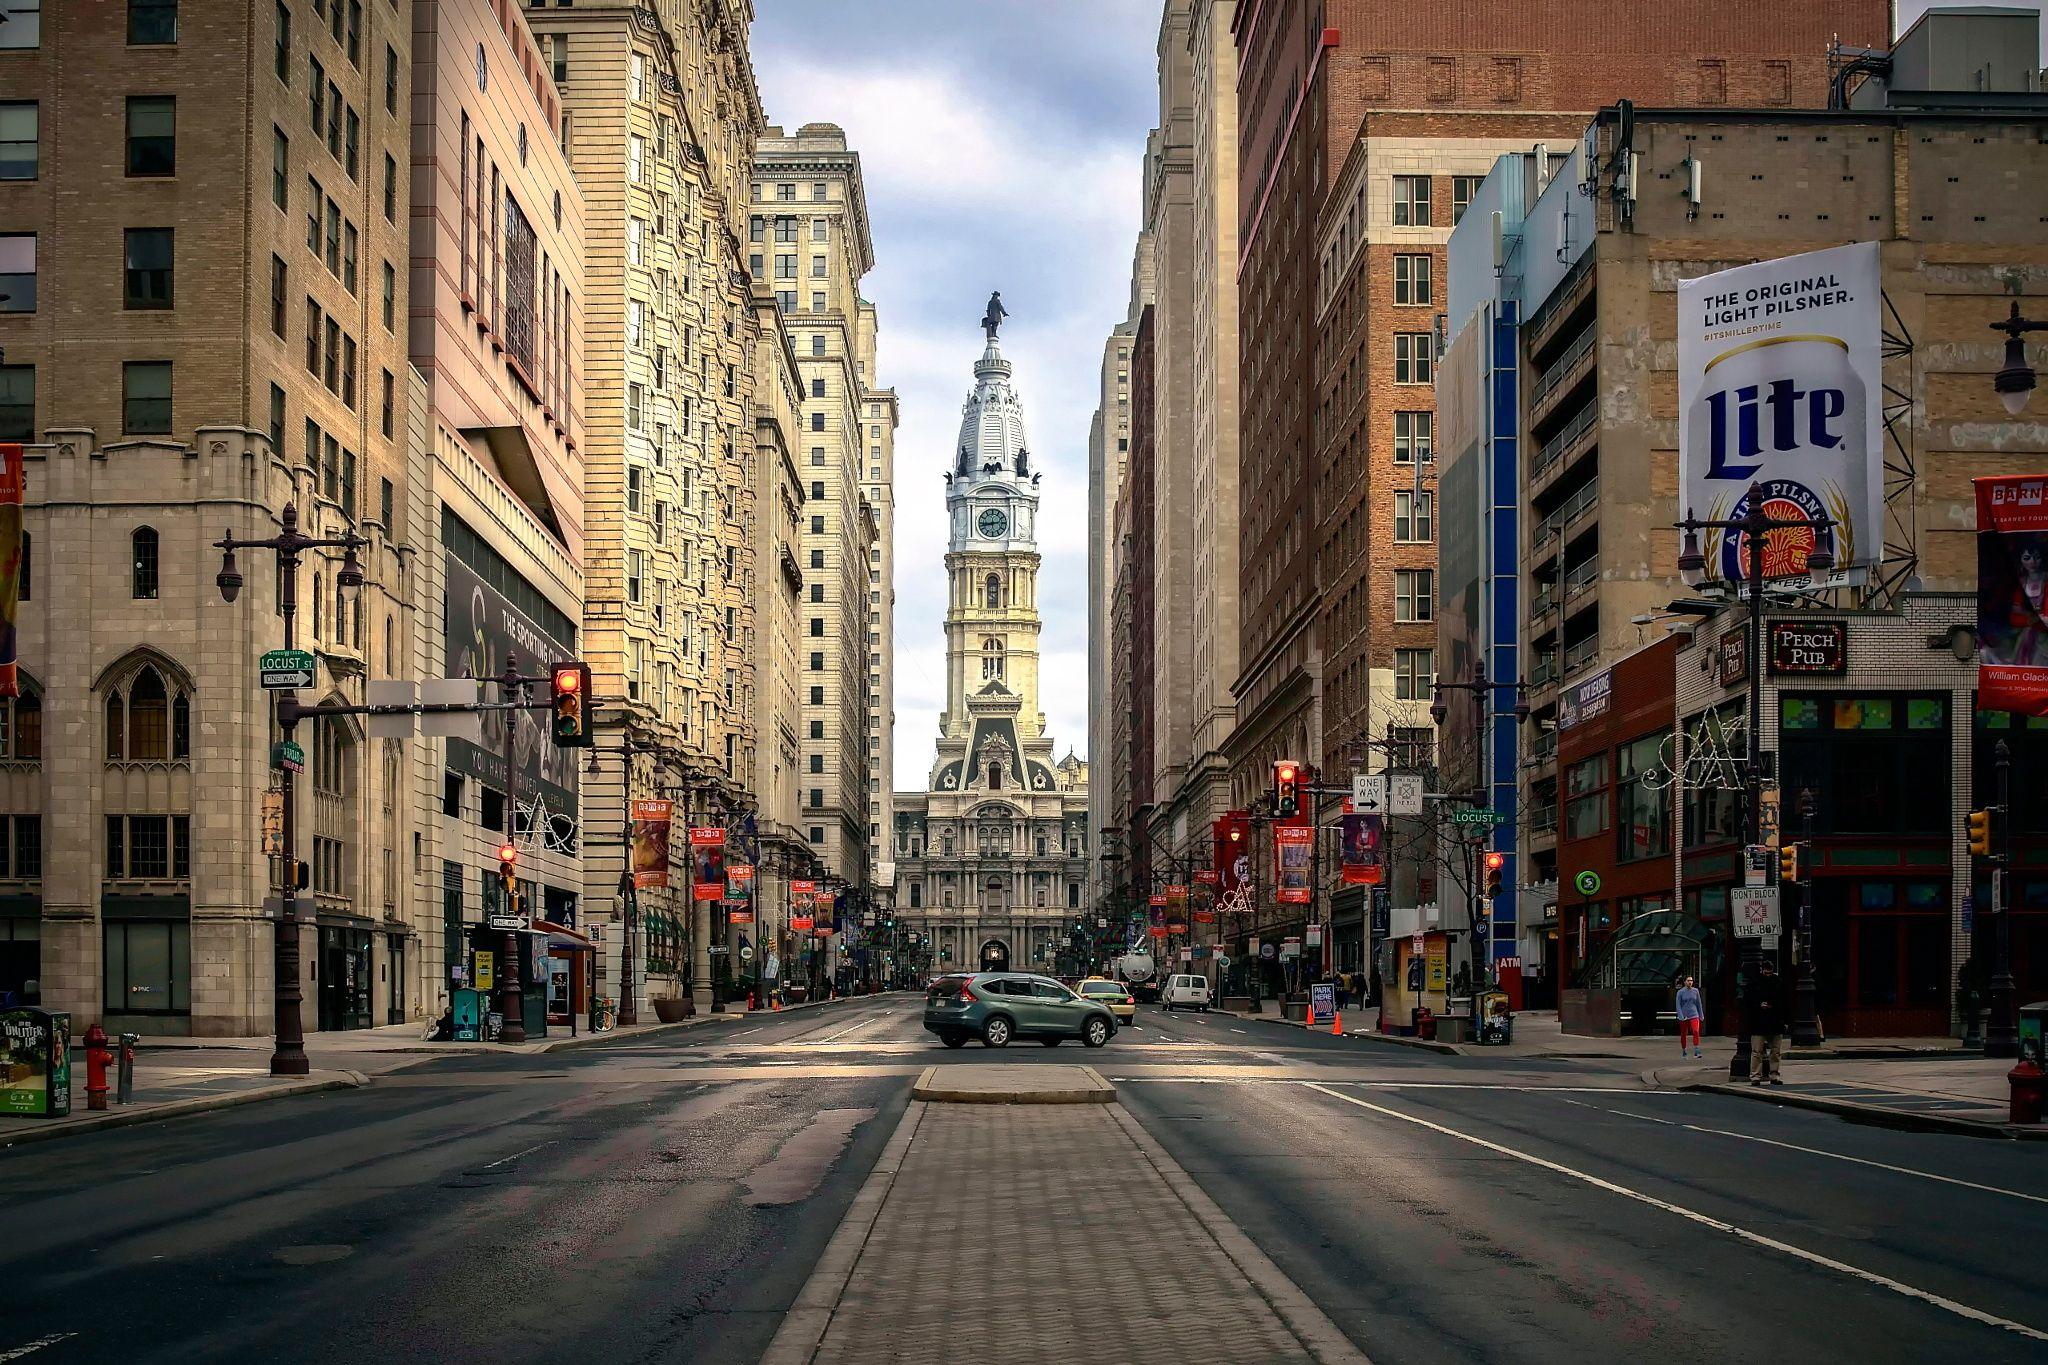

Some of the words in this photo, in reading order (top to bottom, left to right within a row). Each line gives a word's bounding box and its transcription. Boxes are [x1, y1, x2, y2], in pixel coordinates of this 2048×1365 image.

[1703, 292, 1739, 310] THE
[1745, 274, 1840, 302] ORIGINAL
[1704, 306, 1759, 327] LIGHT
[1765, 290, 1855, 317] PILSNER.
[1703, 321, 1782, 342] #ITSMILLERTIME
[1703, 378, 1845, 480] Lite
[1726, 533, 1738, 546] A
[502, 609, 516, 639] THE
[517, 621, 548, 663] SPORTING
[1781, 631, 1835, 648] PERCH
[1725, 640, 1742, 659] PERCH
[1791, 648, 1825, 664] PUB
[261, 658, 301, 669] LOCUST
[1728, 659, 1739, 674] PUB
[266, 675, 281, 683] ONE
[283, 675, 298, 683] WAY
[1988, 671, 2020, 681] William
[471, 749, 486, 773] YOU
[489, 759, 507, 782] HAVE
[1360, 778, 1379, 787] ONE
[1359, 788, 1379, 797] WAY
[1456, 814, 1494, 822] LOCUST
[1754, 889, 1777, 898] BLOCK
[1738, 925, 1755, 934] THE
[1500, 957, 1521, 968] ATM
[25, 1037, 36, 1047] US
